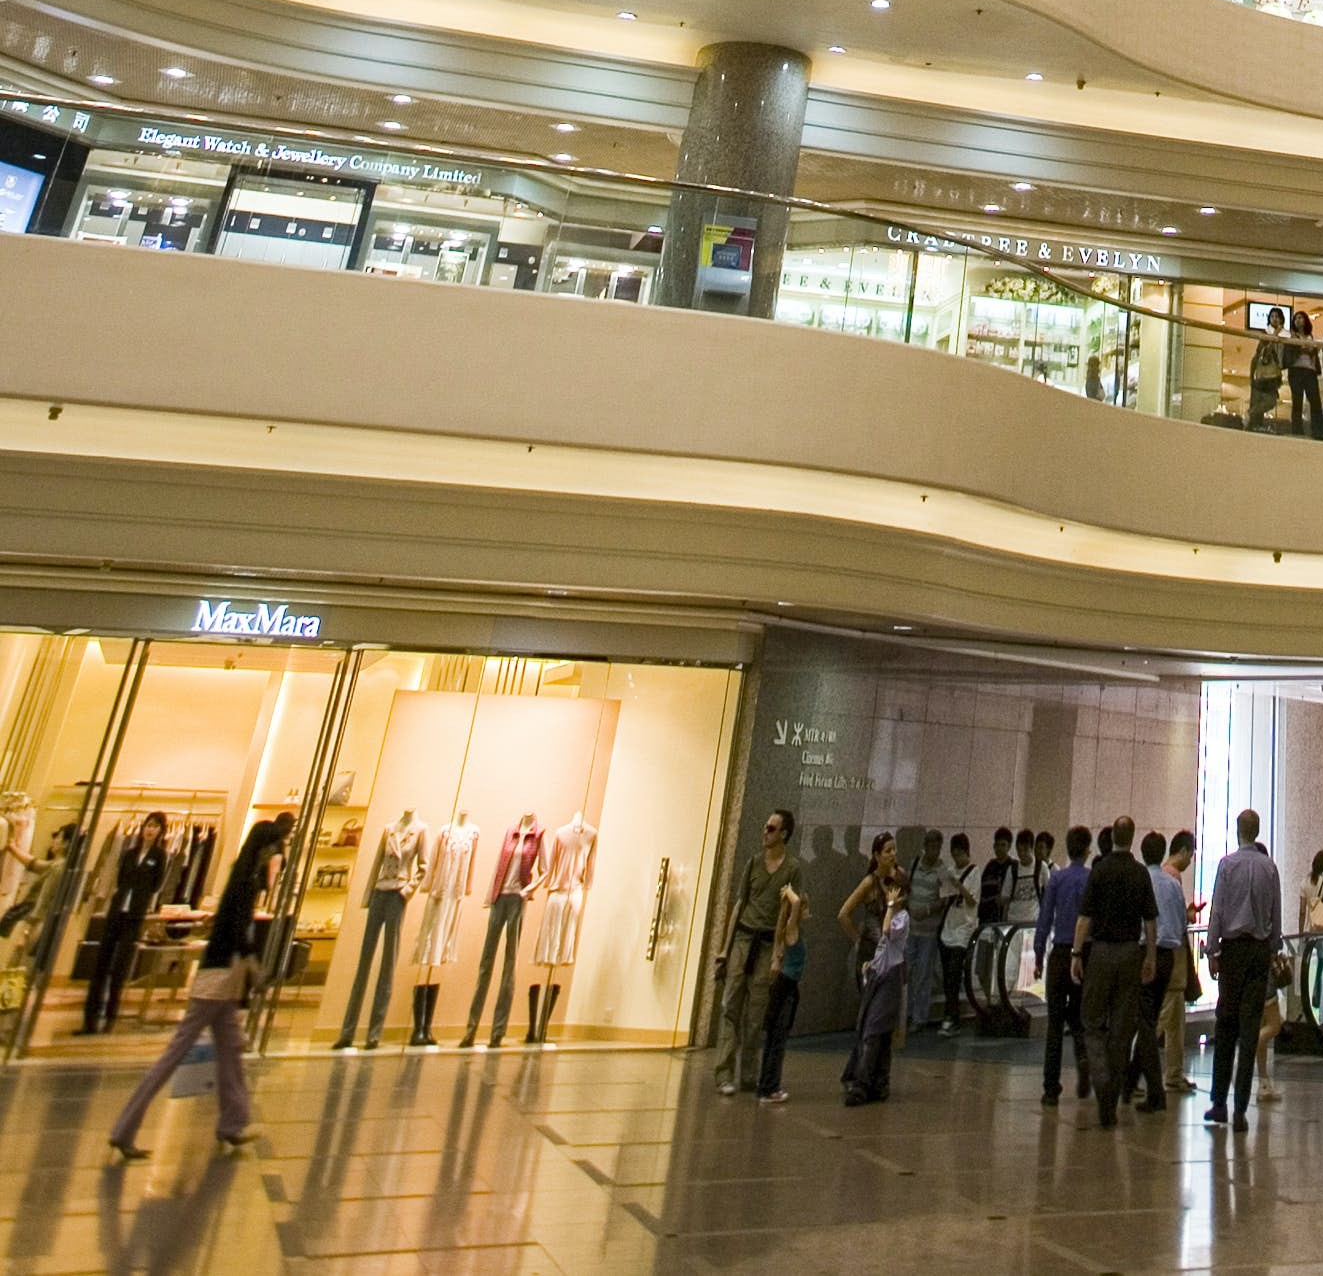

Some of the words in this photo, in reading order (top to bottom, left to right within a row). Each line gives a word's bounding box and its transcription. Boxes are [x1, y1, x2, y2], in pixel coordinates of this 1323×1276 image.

[138, 127, 200, 148] Elegant
[203, 135, 251, 156] Watch
[254, 142, 270, 158] &
[271, 144, 348, 171] Jewellery
[350, 154, 420, 179] Company
[422, 164, 482, 185] Limited
[1038, 242, 1051, 260] &
[1062, 245, 1161, 273] EVELYN
[191, 599, 320, 638] MaxMara
